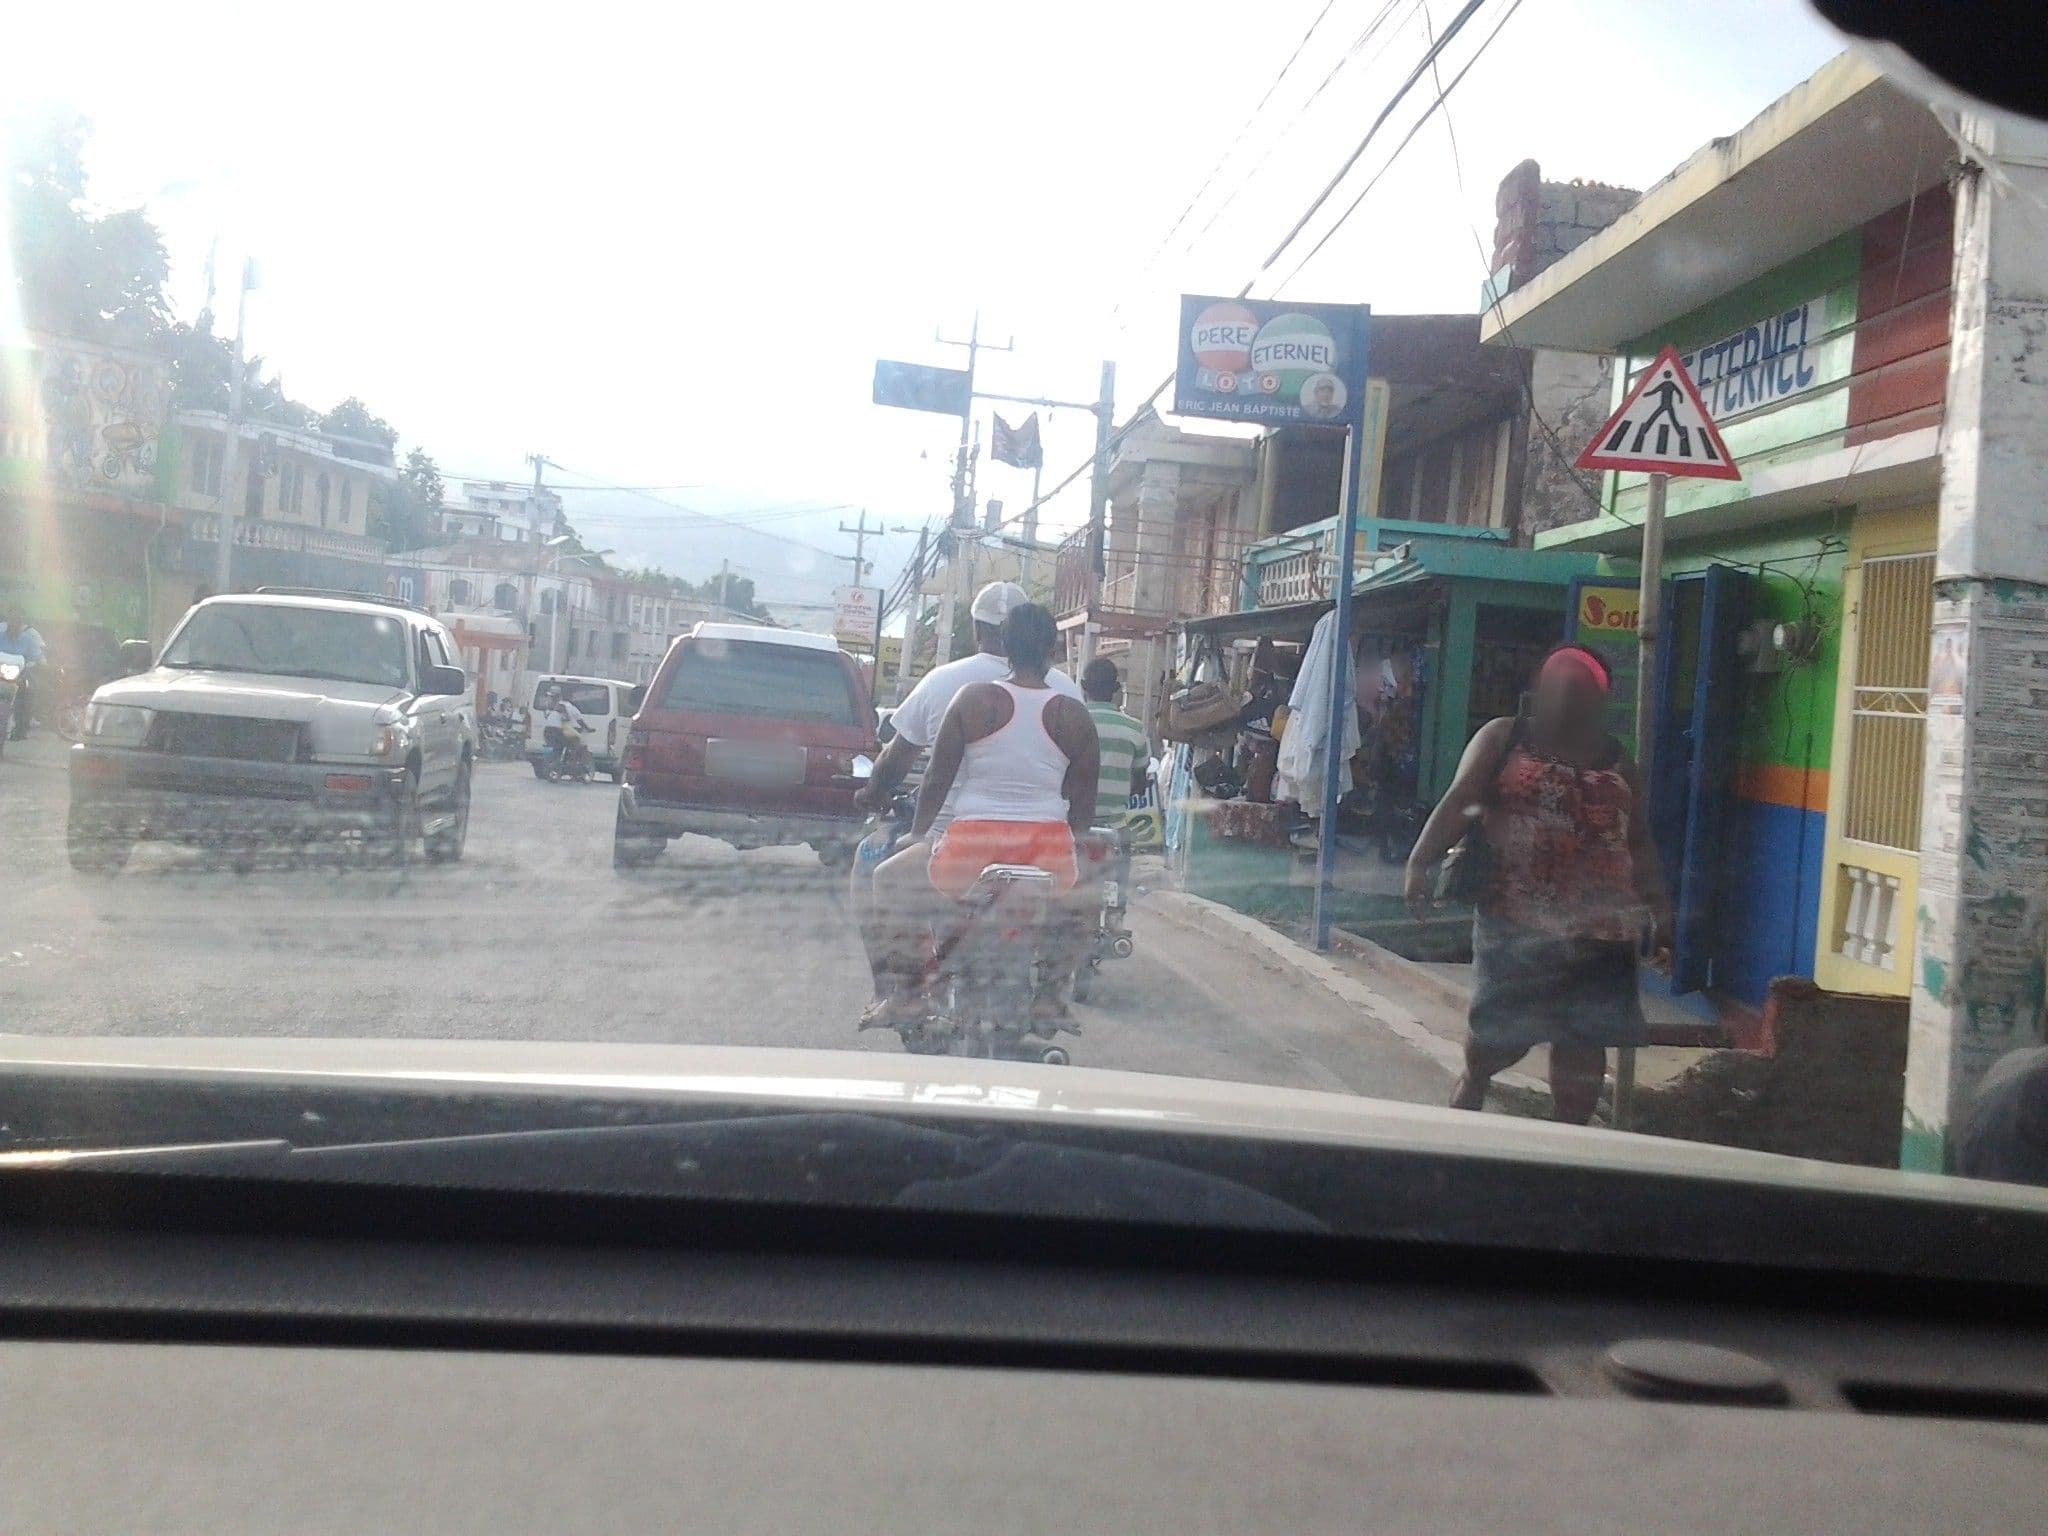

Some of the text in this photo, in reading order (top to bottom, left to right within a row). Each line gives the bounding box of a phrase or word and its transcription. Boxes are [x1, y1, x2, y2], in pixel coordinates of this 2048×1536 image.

[1199, 326, 1250, 346] PERE
[1254, 343, 1335, 365] ETERNEL
[1698, 304, 1813, 416] ETERNEL
[1178, 399, 1301, 417] ERIC JEAN BAPTISTE
